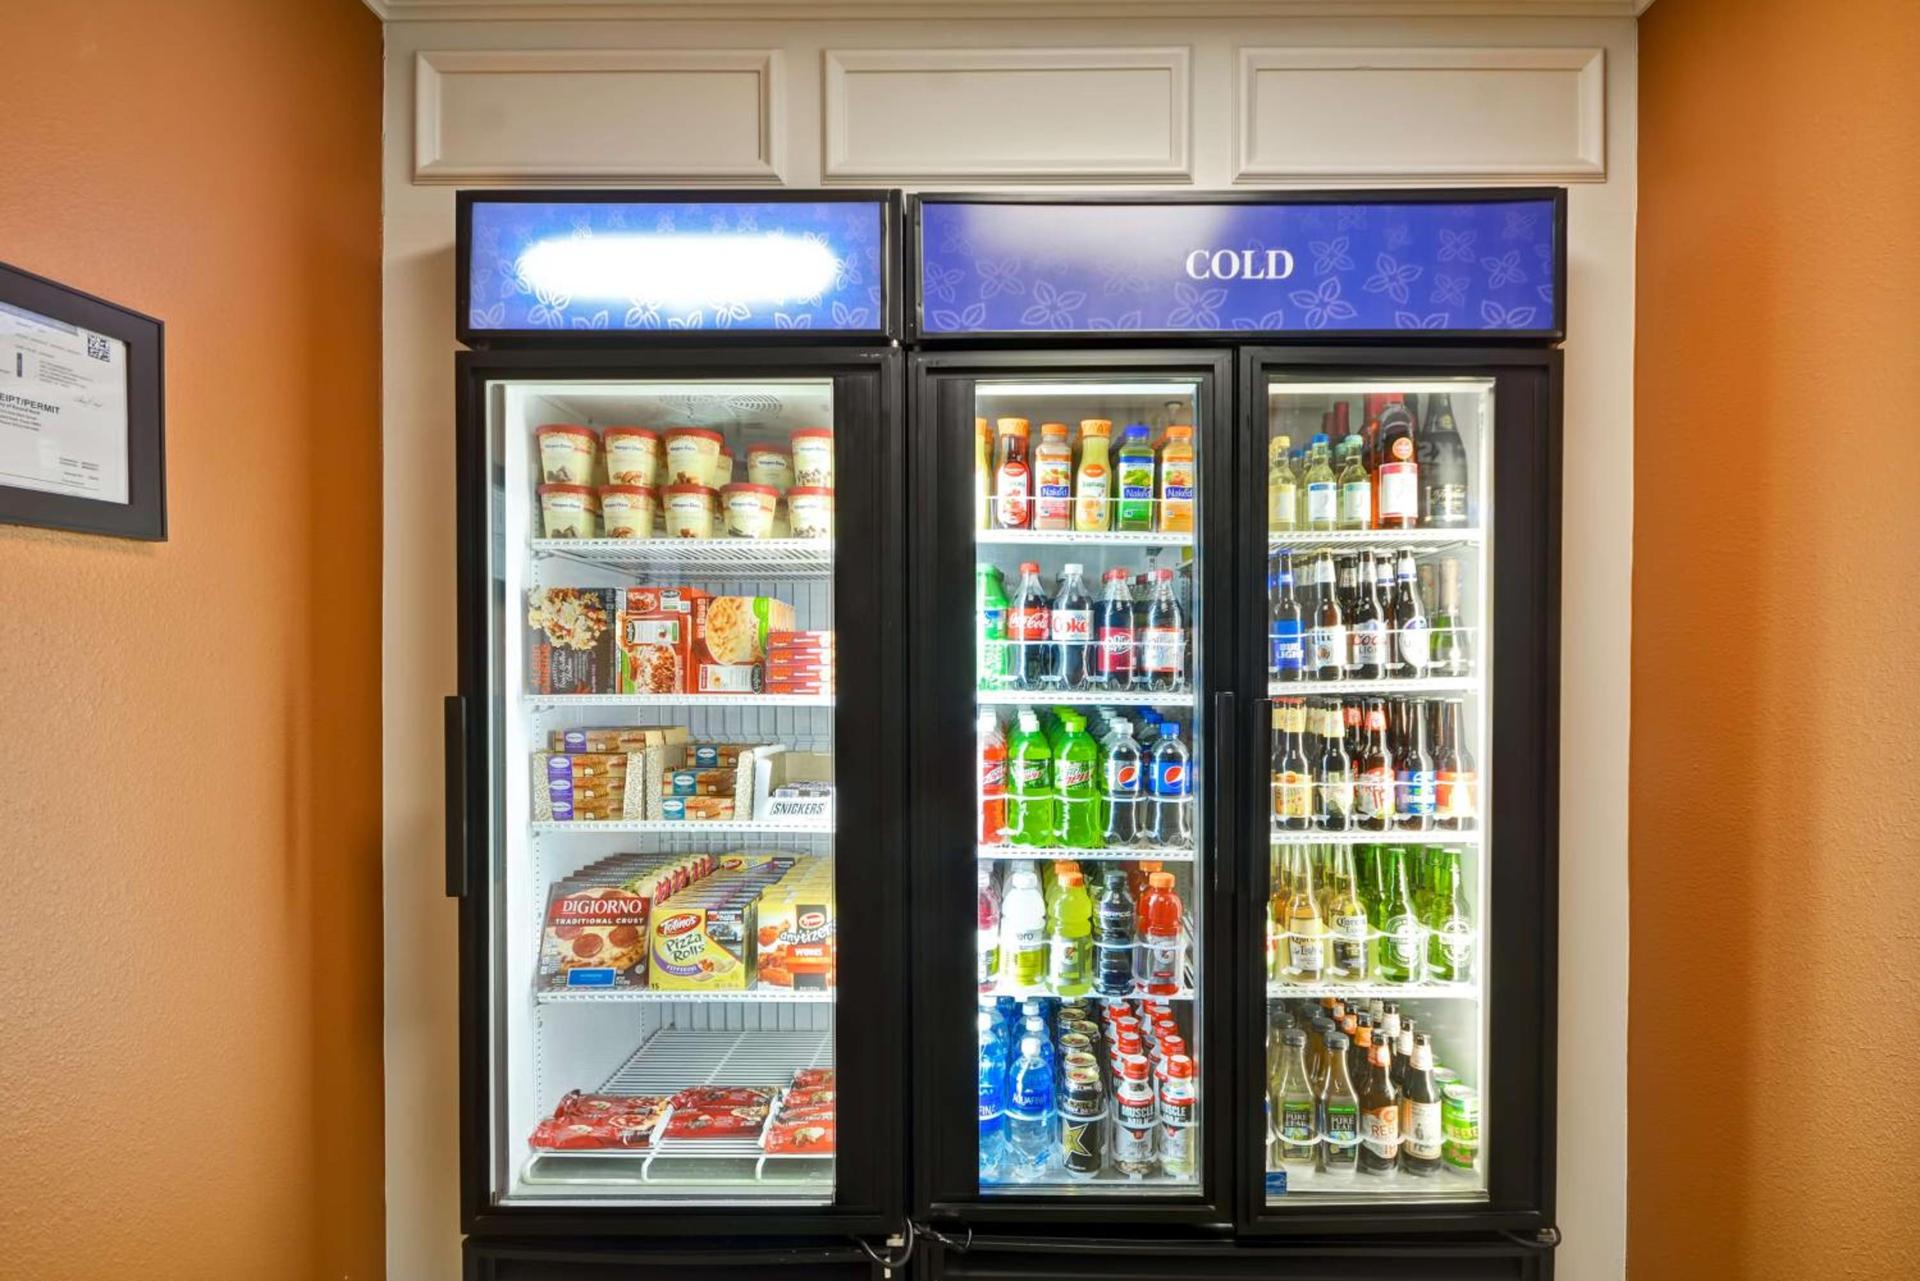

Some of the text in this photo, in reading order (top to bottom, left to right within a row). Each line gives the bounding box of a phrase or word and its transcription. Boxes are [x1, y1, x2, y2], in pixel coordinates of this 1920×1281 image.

[1185, 249, 1294, 280] COLD
[772, 803, 824, 815] SNICKERS
[555, 917, 613, 925] TRADITIONAL
[666, 932, 702, 952] Pizza
[672, 944, 705, 963] Rolls
[1122, 1104, 1153, 1117] MUSCLE
